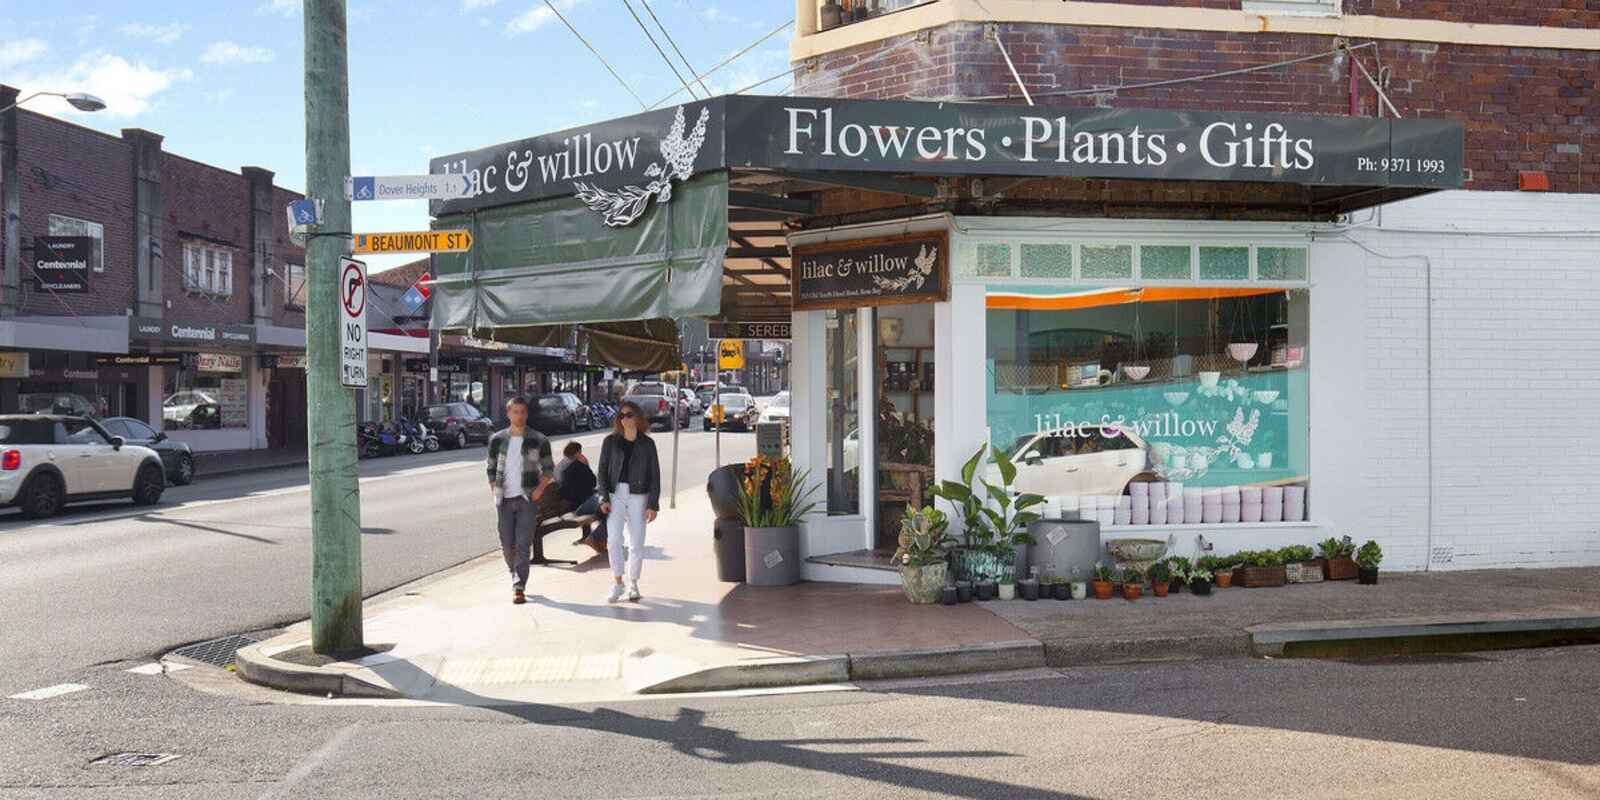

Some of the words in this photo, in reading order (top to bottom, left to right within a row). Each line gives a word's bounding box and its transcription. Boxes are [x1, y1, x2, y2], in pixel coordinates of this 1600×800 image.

[784, 106, 987, 162] Flowers
[1019, 115, 1168, 165] Plants
[1199, 122, 1315, 171] Gifts
[504, 150, 534, 192] &
[537, 131, 641, 185] willow
[1357, 157, 1378, 171] Ph:
[1381, 157, 1411, 172] 9371
[1417, 159, 1446, 173] 1993
[379, 182, 403, 195] Dover
[406, 181, 438, 198] Heights
[372, 233, 440, 252] BEAUMONT
[447, 232, 463, 249] ST
[36, 259, 87, 270] Centennial
[802, 258, 833, 279] lilac
[837, 256, 853, 277] &
[856, 252, 909, 274] willow
[171, 325, 216, 340] Centennial
[346, 322, 361, 343] NO
[748, 323, 793, 338] SEREB
[344, 346, 364, 361] RIGHT
[344, 364, 365, 380] TURN
[1034, 413, 1093, 439] lilac
[1099, 413, 1125, 440] &
[1132, 412, 1218, 439] willow
